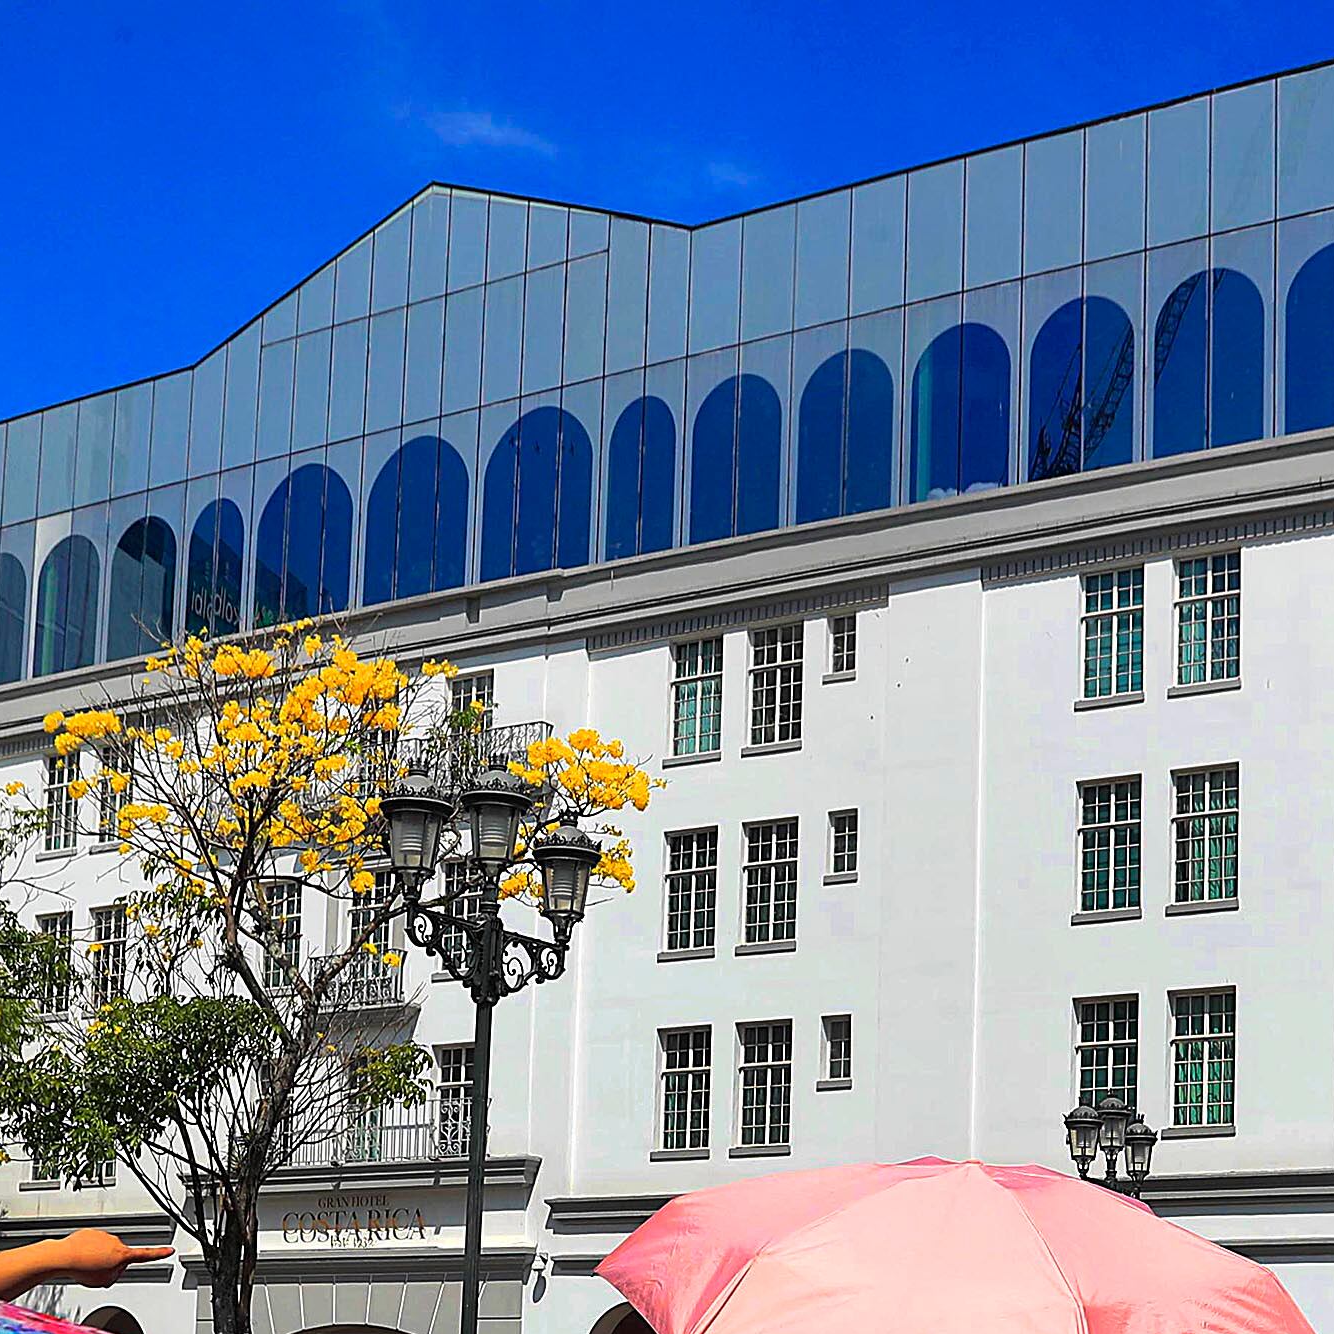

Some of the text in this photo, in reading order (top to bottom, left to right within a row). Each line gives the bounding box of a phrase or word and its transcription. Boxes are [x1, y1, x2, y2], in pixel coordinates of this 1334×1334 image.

[318, 1195, 390, 1208] GRAN HOTEL
[282, 1208, 425, 1235] COSTA RICA
